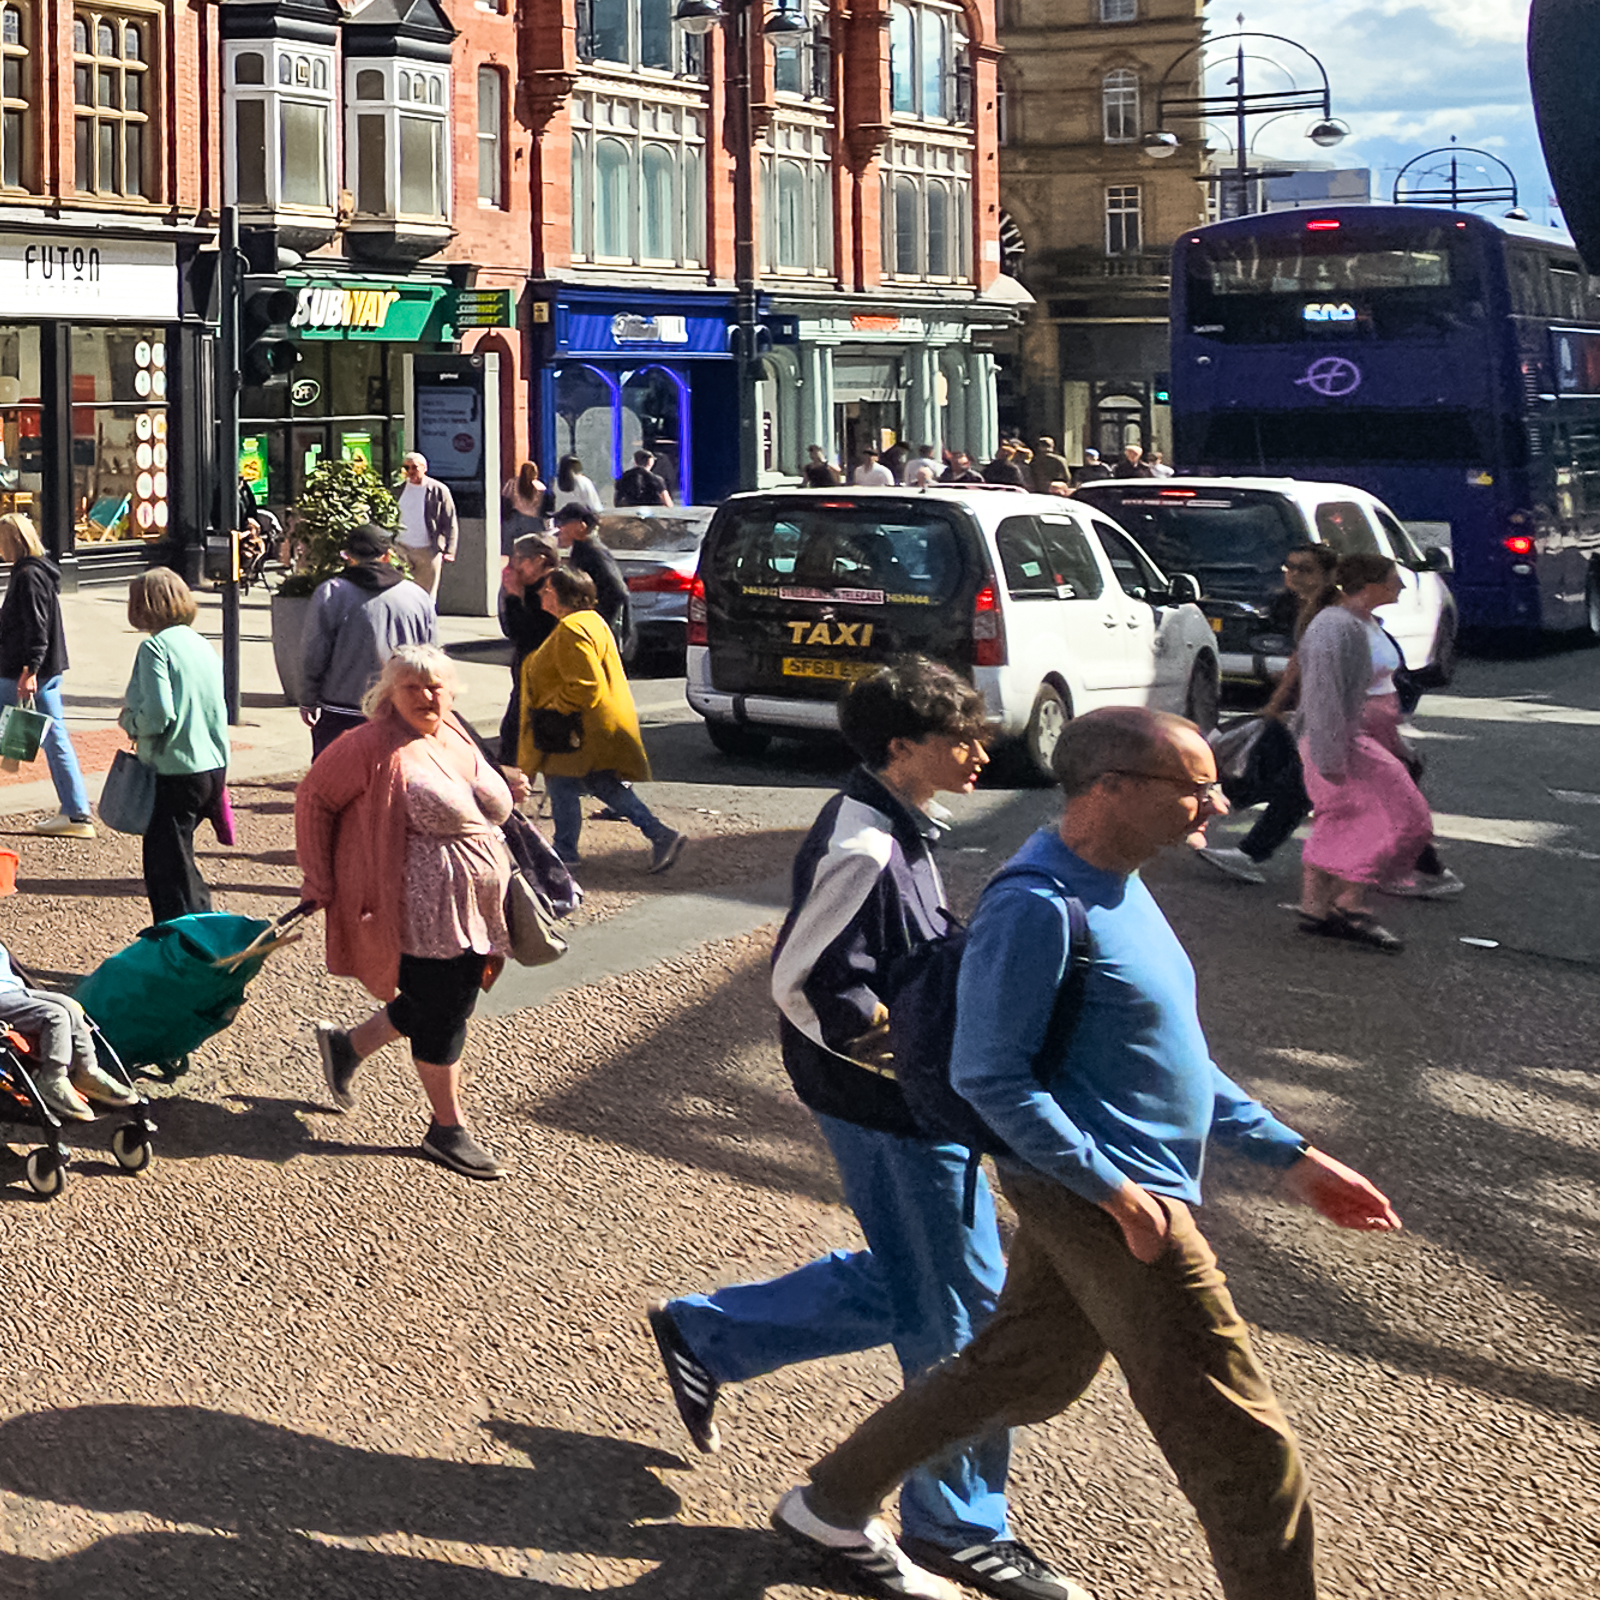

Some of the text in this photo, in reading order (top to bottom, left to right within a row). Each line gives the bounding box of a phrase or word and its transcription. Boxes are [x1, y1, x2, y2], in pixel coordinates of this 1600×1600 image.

[998, 213, 1026, 255] ITY
[24, 244, 101, 281] FUTON
[291, 287, 400, 328] SUBWAY
[786, 621, 874, 647] TAXI
